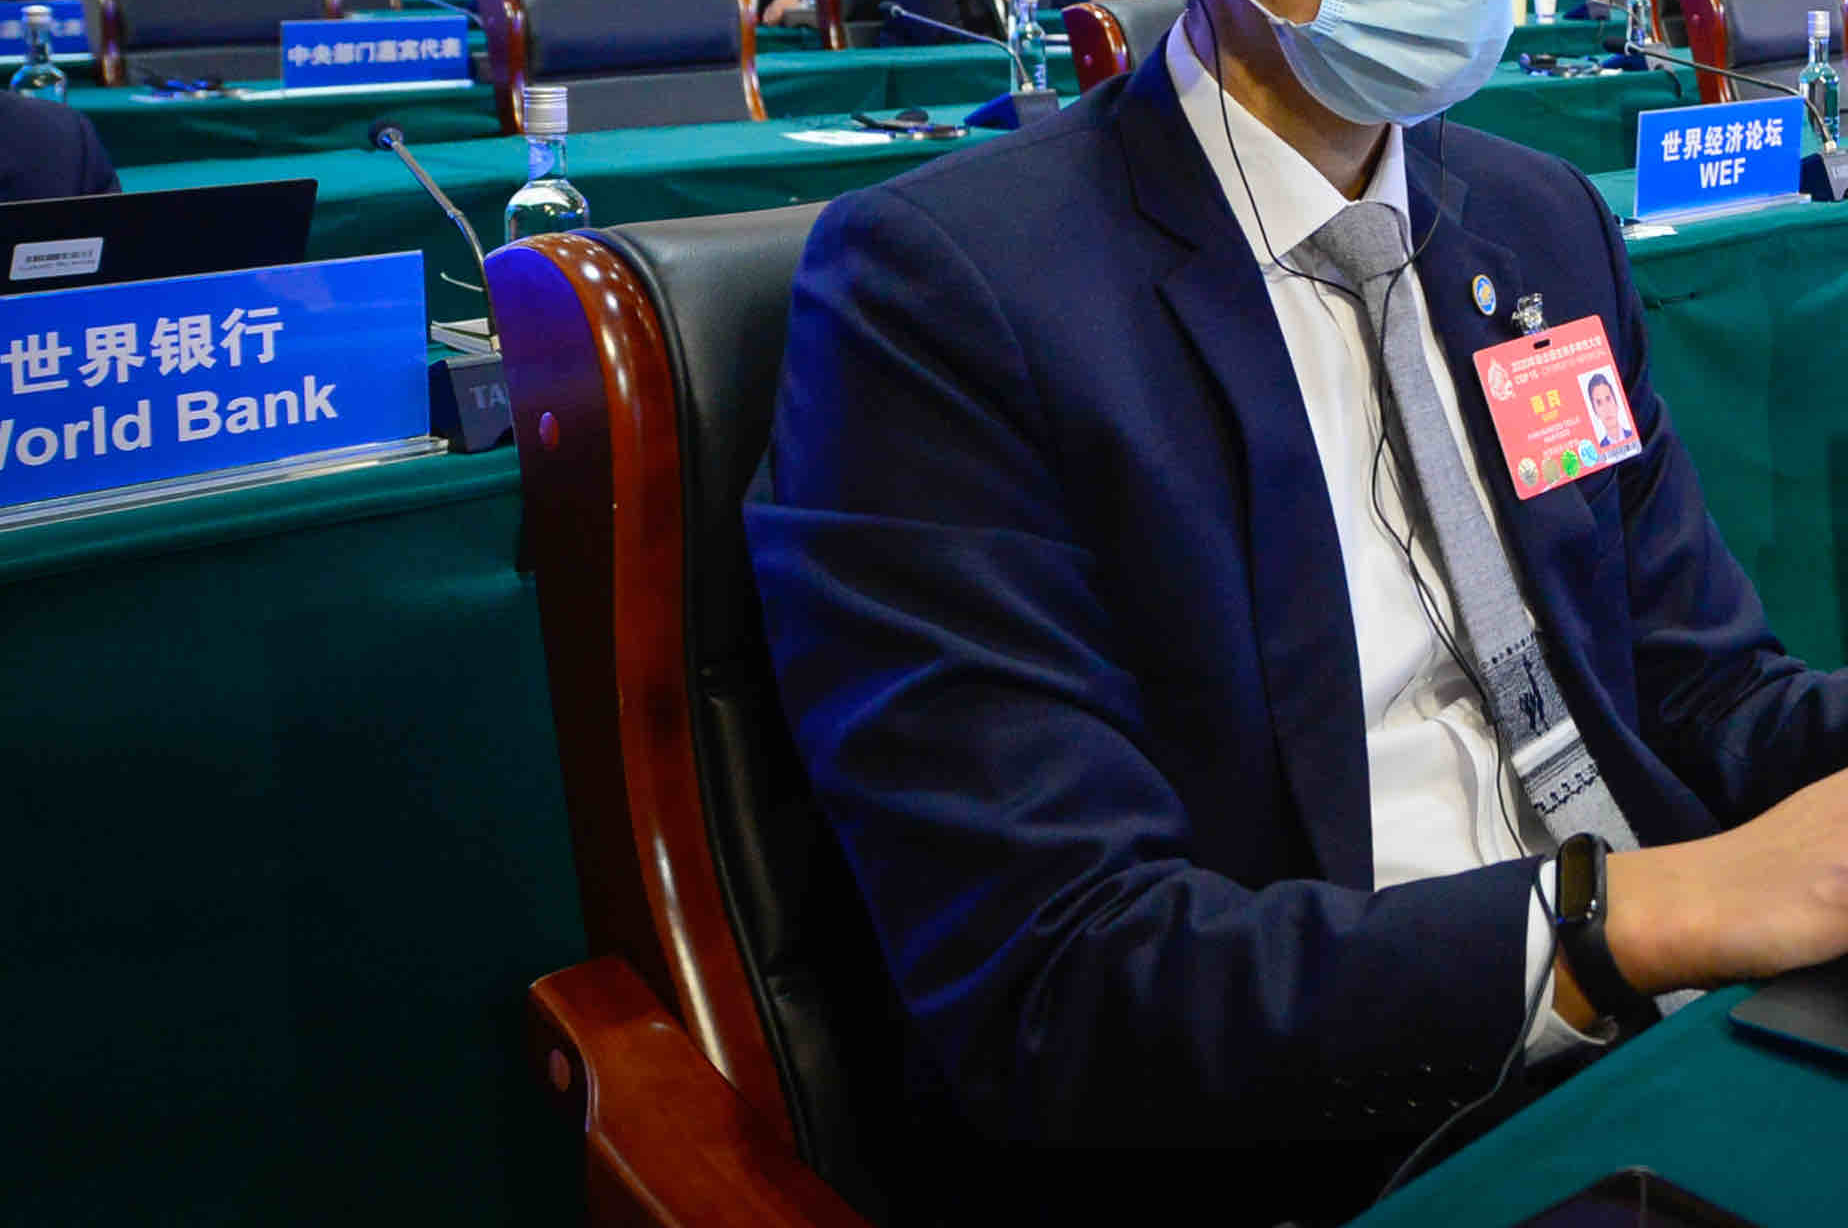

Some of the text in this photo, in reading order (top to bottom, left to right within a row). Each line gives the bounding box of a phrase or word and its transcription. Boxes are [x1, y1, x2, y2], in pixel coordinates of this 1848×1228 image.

[1660, 118, 1783, 163] 世界经济论坛
[1700, 157, 1747, 189] WEF
[1, 305, 285, 396] 世界银行
[176, 375, 339, 442] Bank
